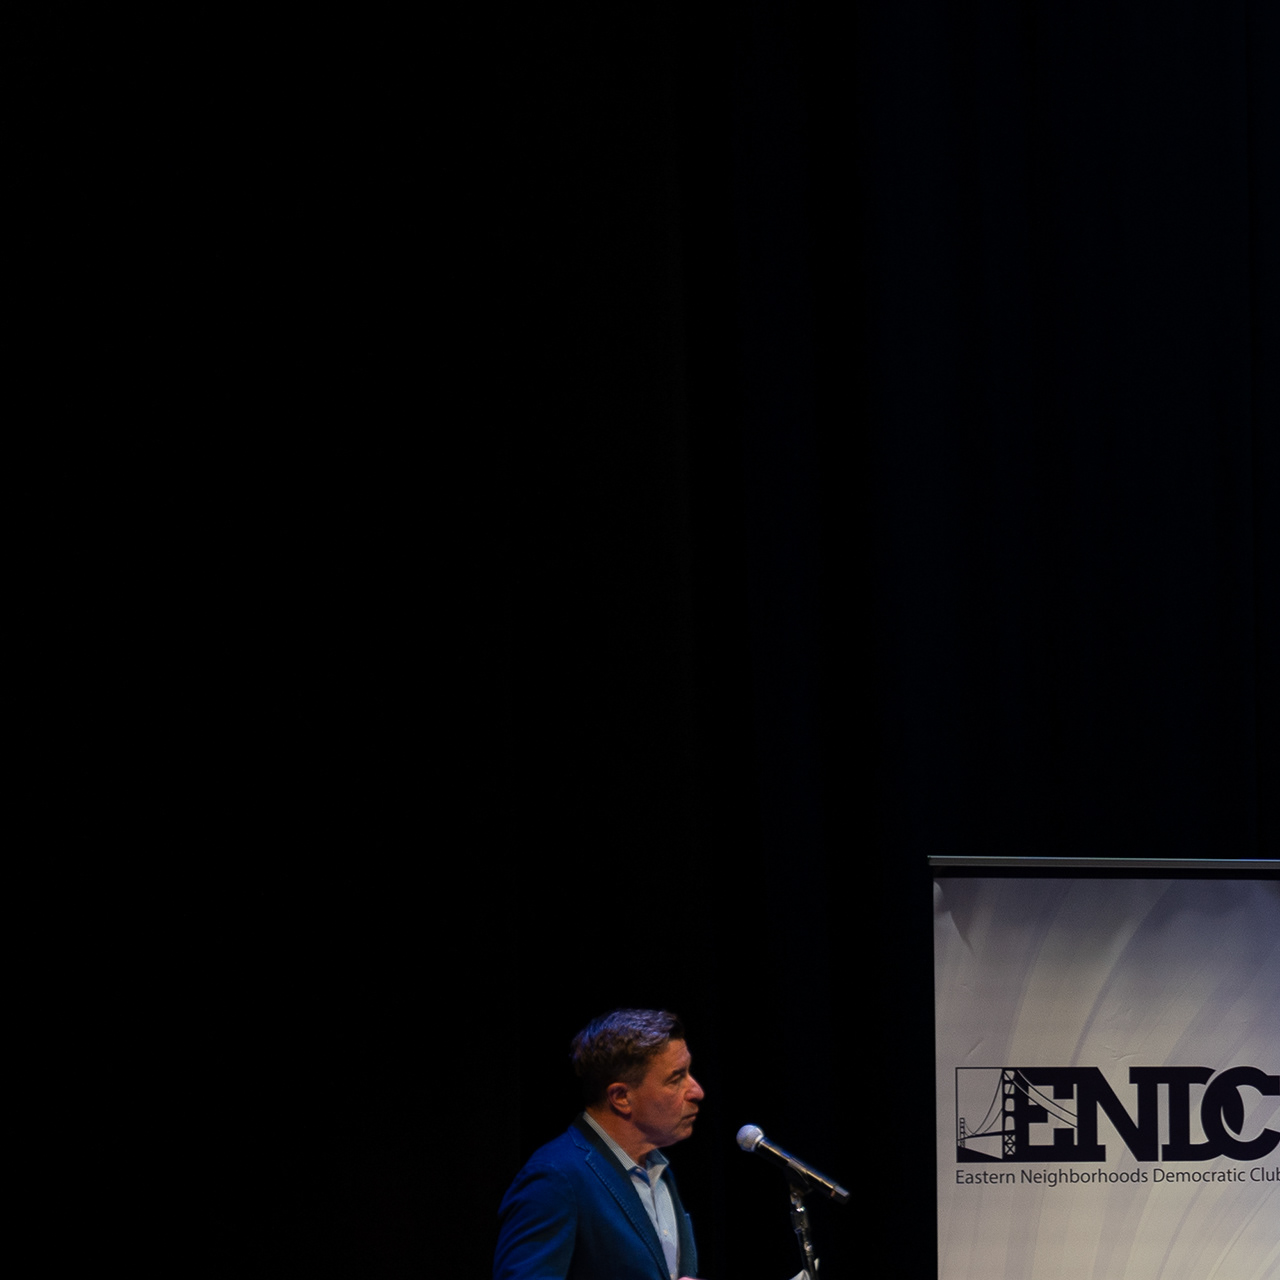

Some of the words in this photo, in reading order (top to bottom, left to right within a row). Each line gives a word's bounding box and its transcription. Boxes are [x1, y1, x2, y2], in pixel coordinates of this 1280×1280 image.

[955, 1169, 1016, 1184] Eastern
[1020, 1168, 1148, 1187] Neighborhoods
[1153, 1168, 1246, 1183] Democratic
